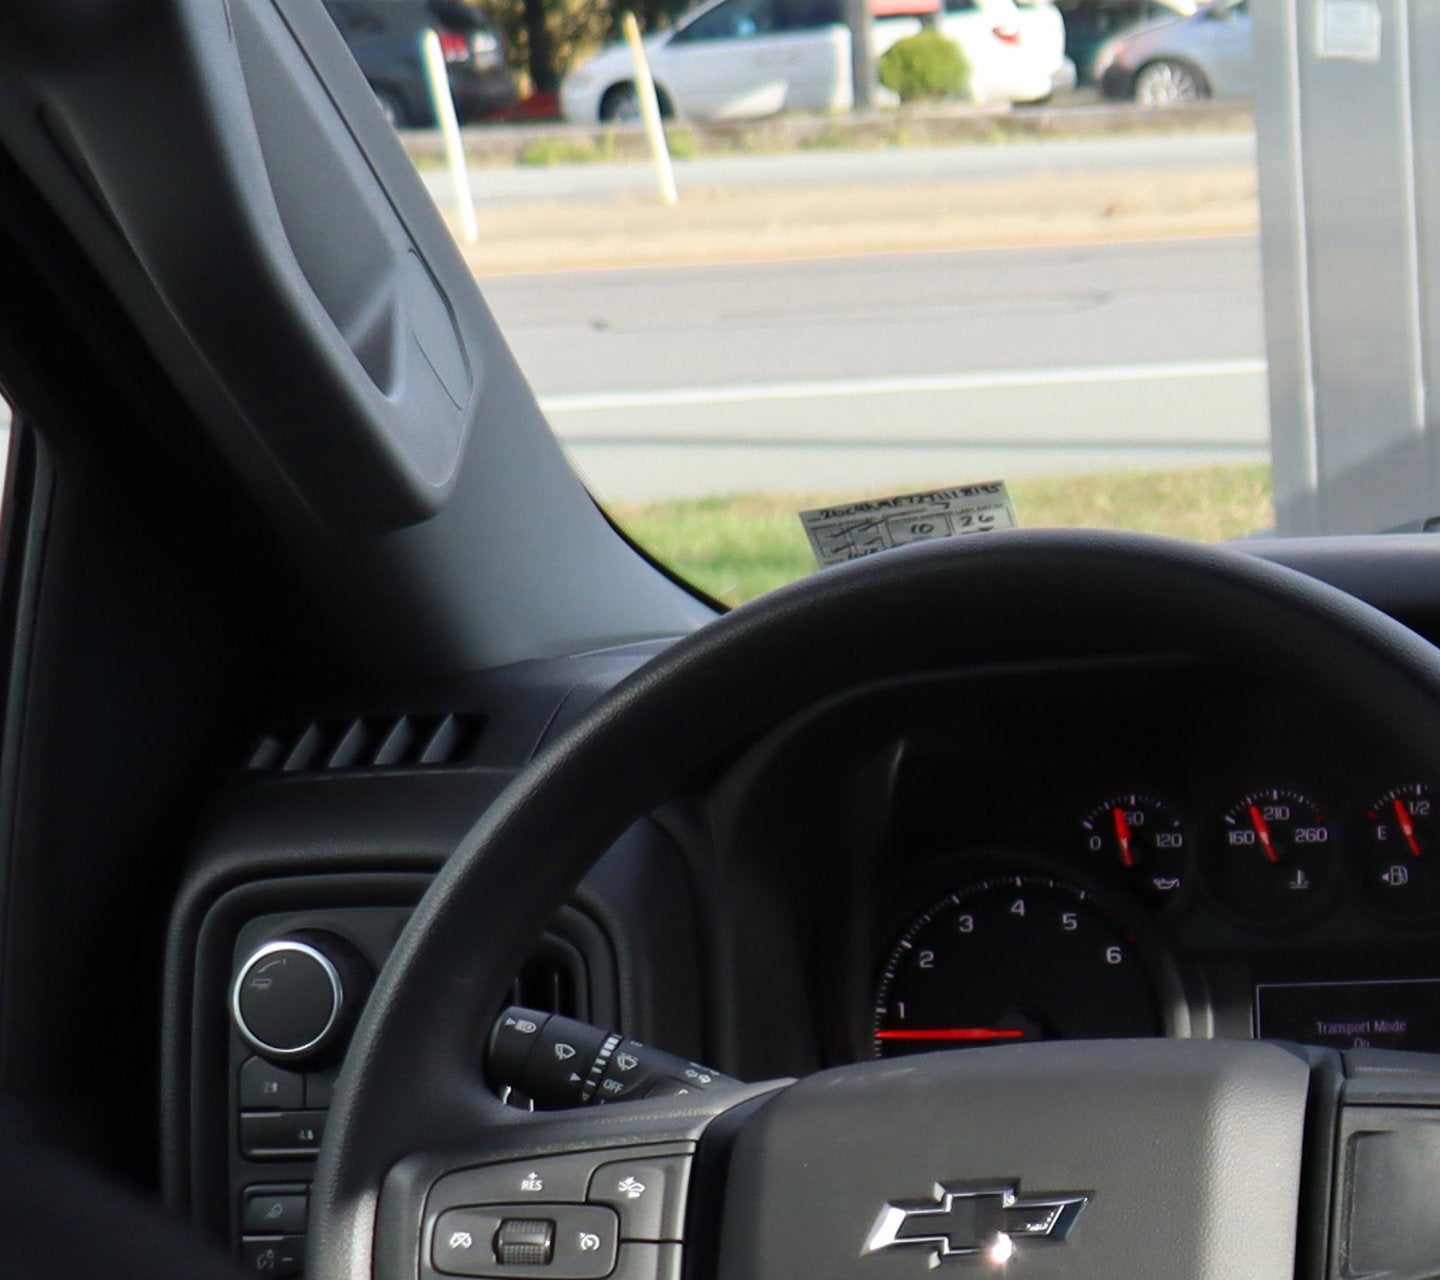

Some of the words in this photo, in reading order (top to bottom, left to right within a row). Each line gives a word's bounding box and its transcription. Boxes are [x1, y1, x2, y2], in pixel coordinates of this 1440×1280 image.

[1262, 806, 1289, 822] 210
[1408, 800, 1431, 818] 1/2
[1155, 833, 1182, 849] 120
[1227, 830, 1255, 846] 160
[1294, 827, 1328, 842] 260
[1376, 825, 1387, 840] E
[1088, 835, 1102, 851] 0
[1010, 898, 1026, 917] 4
[959, 914, 975, 933] 3
[1061, 912, 1078, 931] 5
[919, 950, 935, 969] 2
[1105, 945, 1122, 964] 6
[897, 1001, 905, 1019] 1
[1316, 1020, 1370, 1036] Transport
[1374, 1019, 1406, 1033] Mode
[602, 1076, 625, 1095] OFF
[520, 1179, 543, 1192] RES
